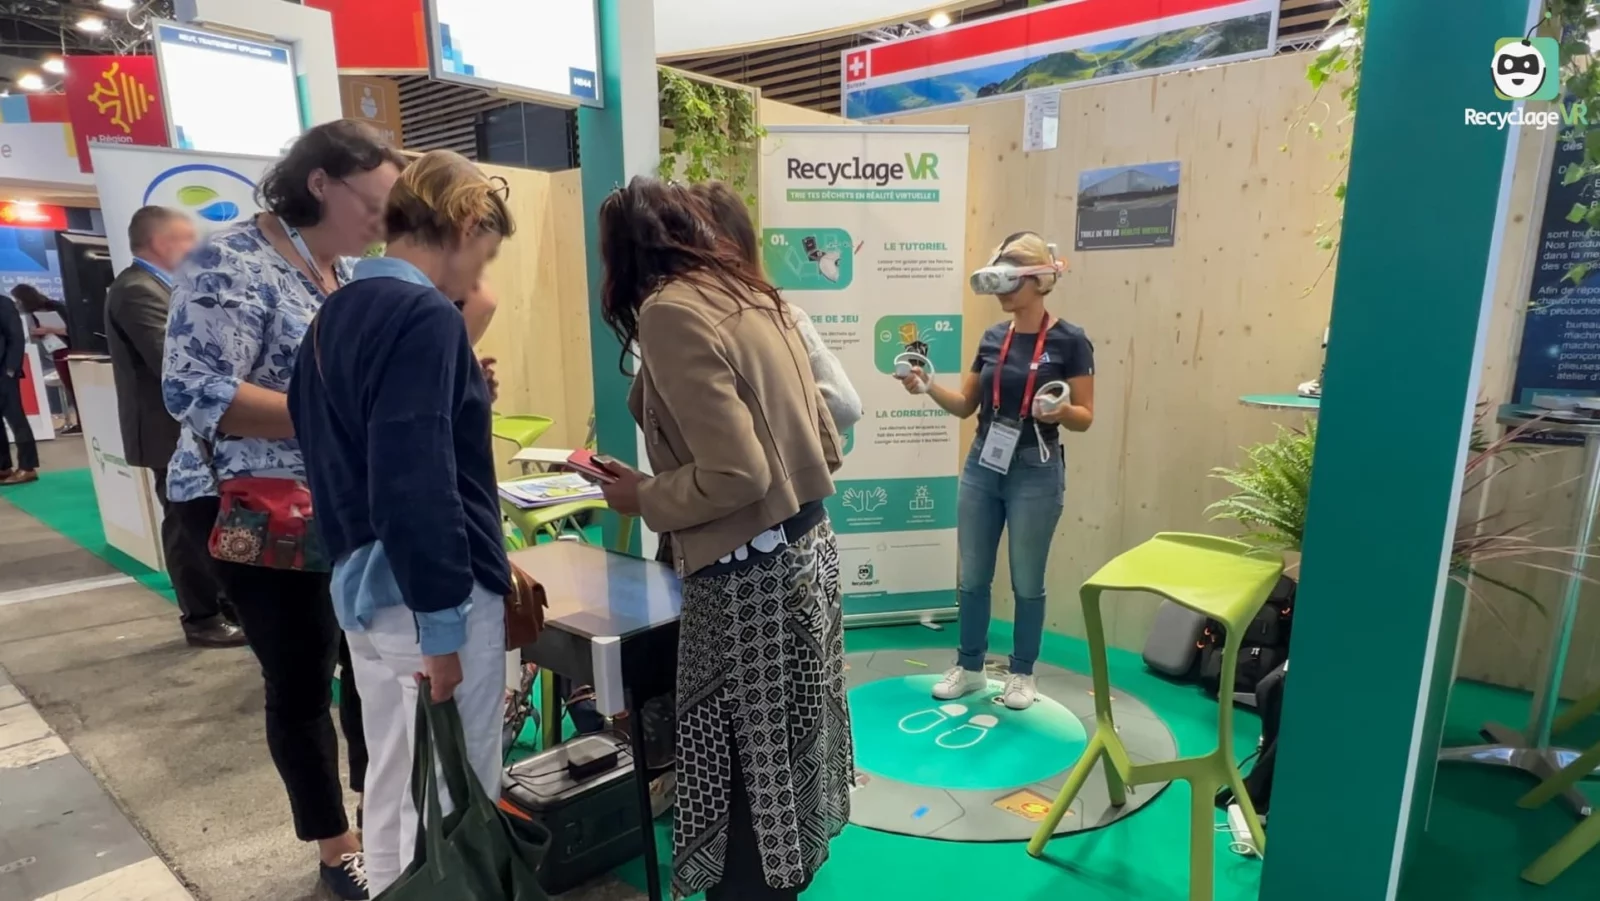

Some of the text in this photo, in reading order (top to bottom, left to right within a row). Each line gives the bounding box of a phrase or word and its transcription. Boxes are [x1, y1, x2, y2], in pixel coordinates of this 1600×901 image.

[821, 190, 854, 199] DÉCHETS
[866, 190, 894, 199] RÉALITÉ
[771, 234, 789, 245] 01.
[1547, 231, 1569, 239] sont
[884, 242, 948, 251] LE TUTORIEL
[1545, 241, 1566, 250] Nos
[1543, 251, 1568, 260] dans
[1571, 251, 1580, 259] la
[1541, 262, 1560, 270] des
[1538, 286, 1558, 294] Afin
[825, 315, 839, 323] DE
[841, 315, 859, 323] JEU
[935, 320, 953, 331] 02.
[876, 410, 888, 418] LA
